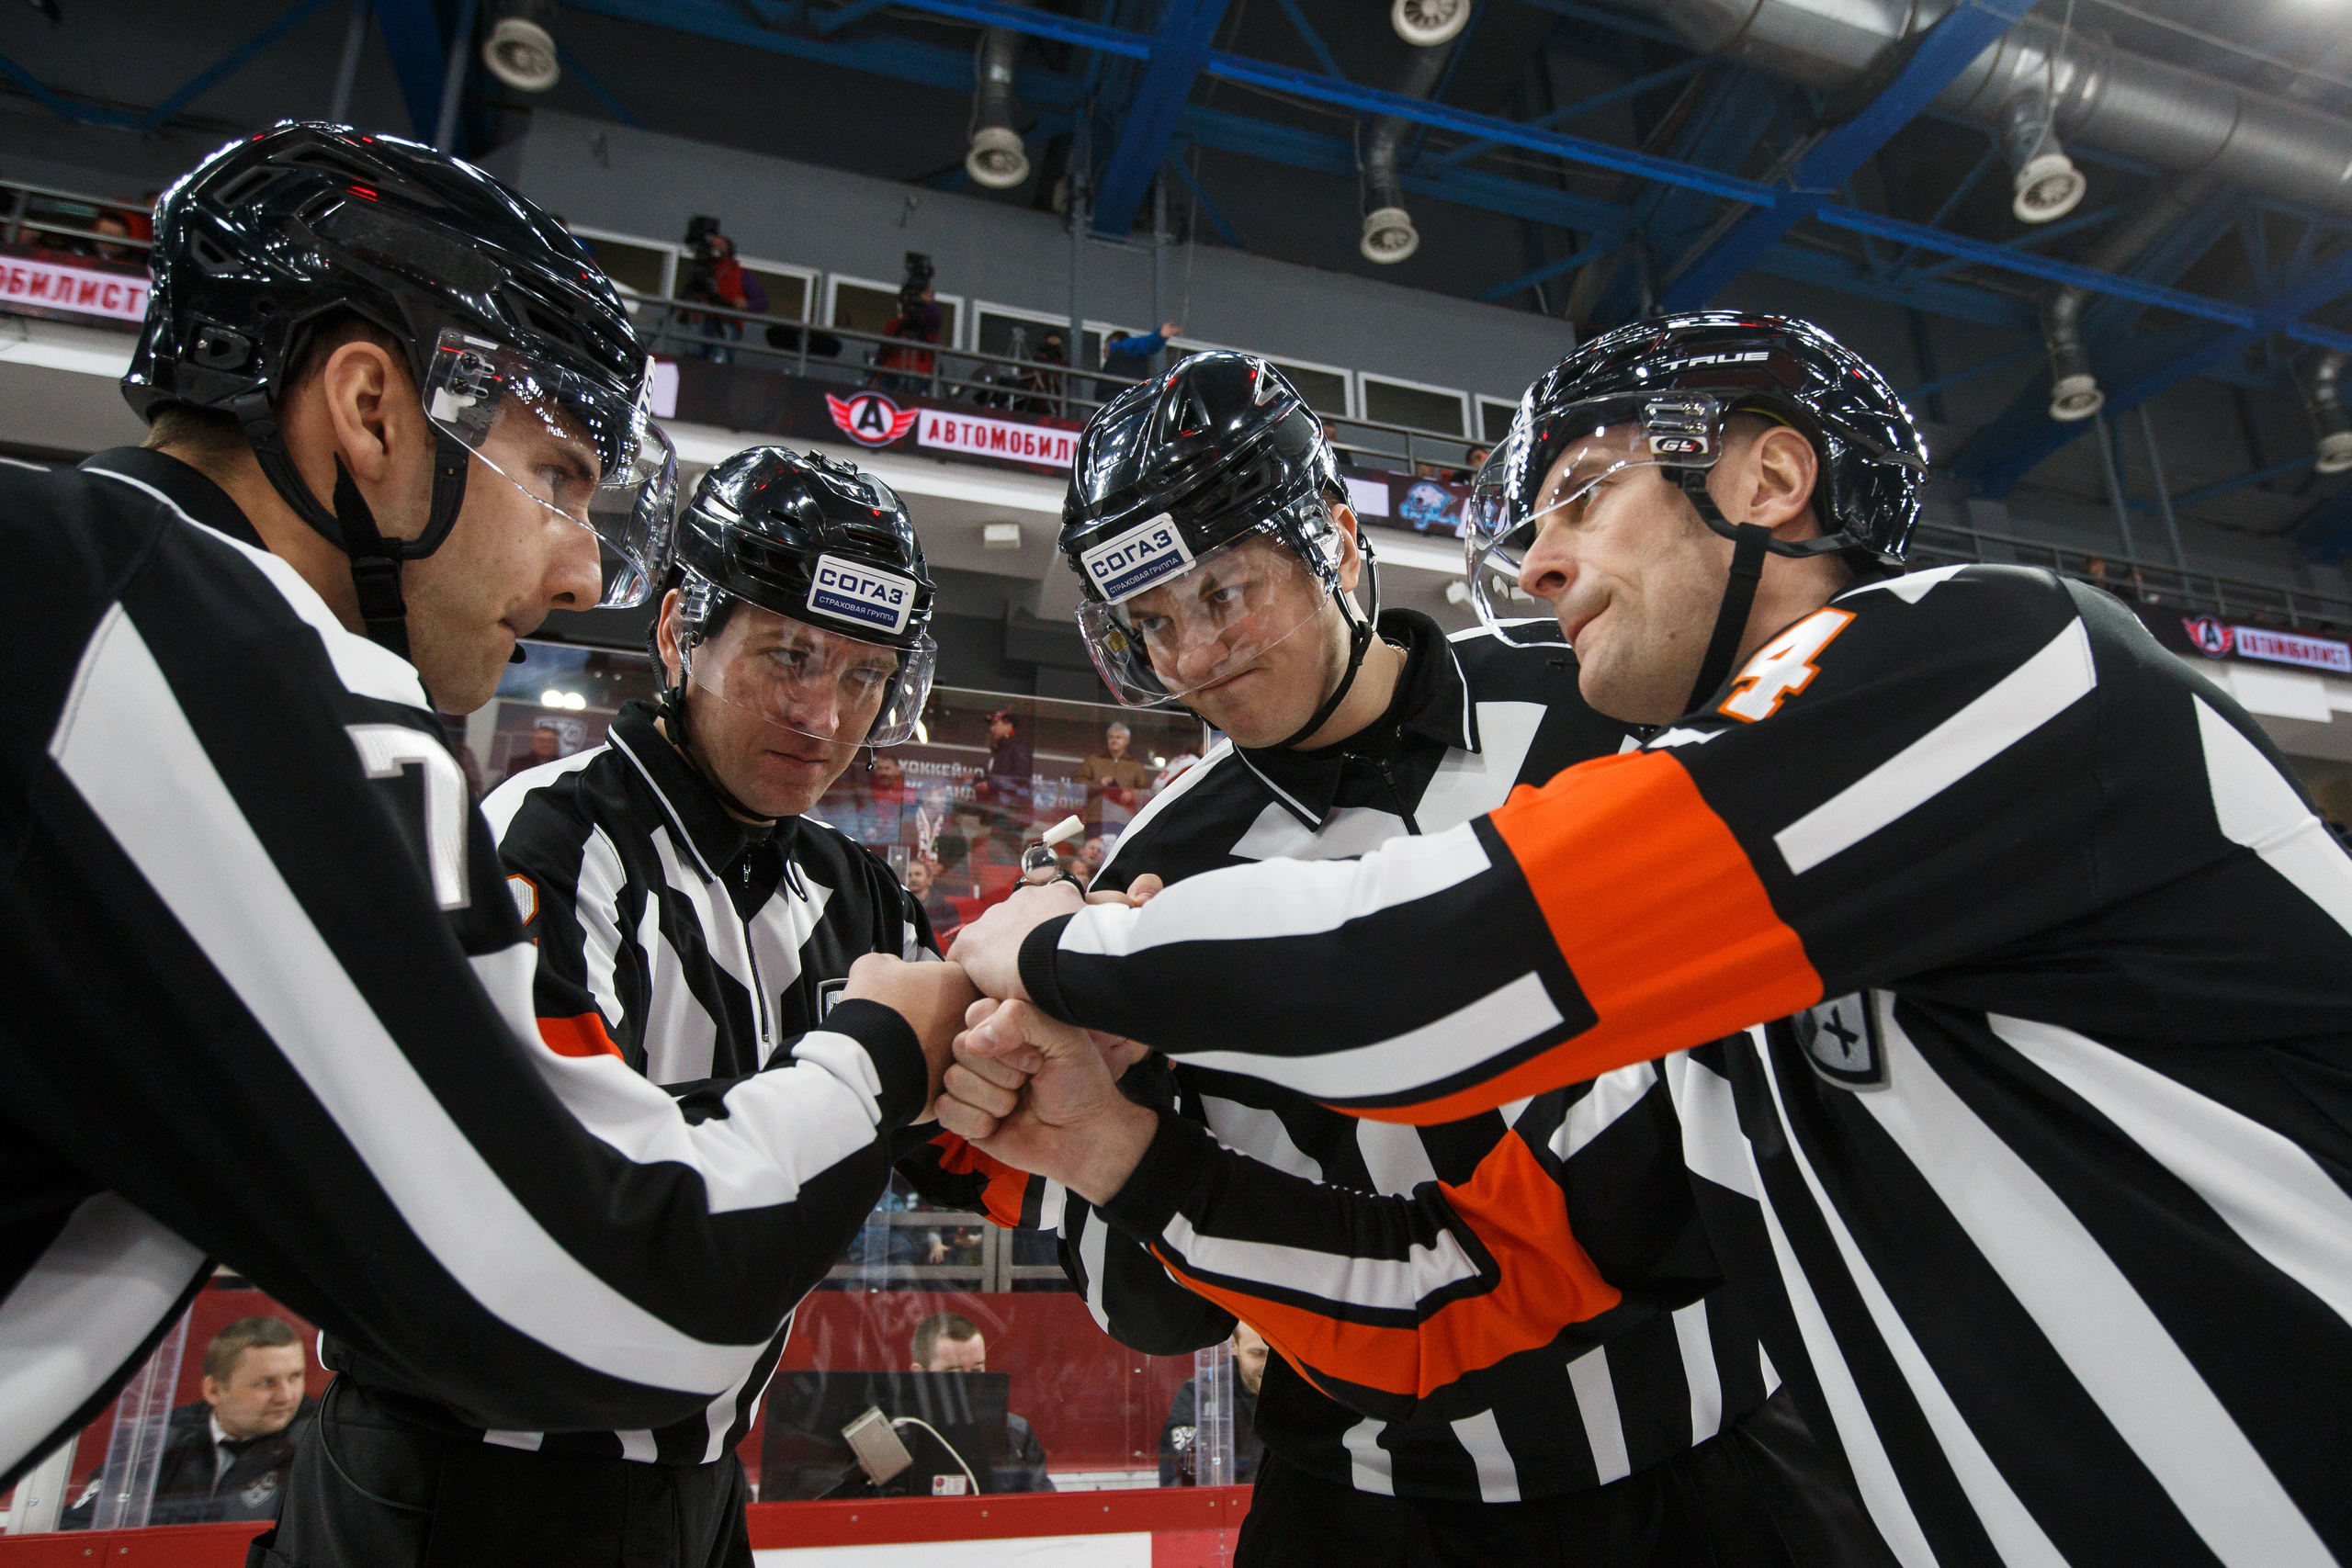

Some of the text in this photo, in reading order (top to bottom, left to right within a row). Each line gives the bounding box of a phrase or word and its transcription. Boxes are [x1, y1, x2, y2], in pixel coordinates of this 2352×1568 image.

[1660, 351, 1770, 370] TRUE
[1091, 528, 1173, 579] СОГАЗ
[819, 568, 904, 605] СОГАЗ
[1109, 557, 1180, 594] СТРАХОВАЯ ГРУППА
[819, 595, 895, 622] СТРАХОВАЯ ГРУППА
[1718, 606, 1857, 724] 4
[344, 723, 472, 911] 7
